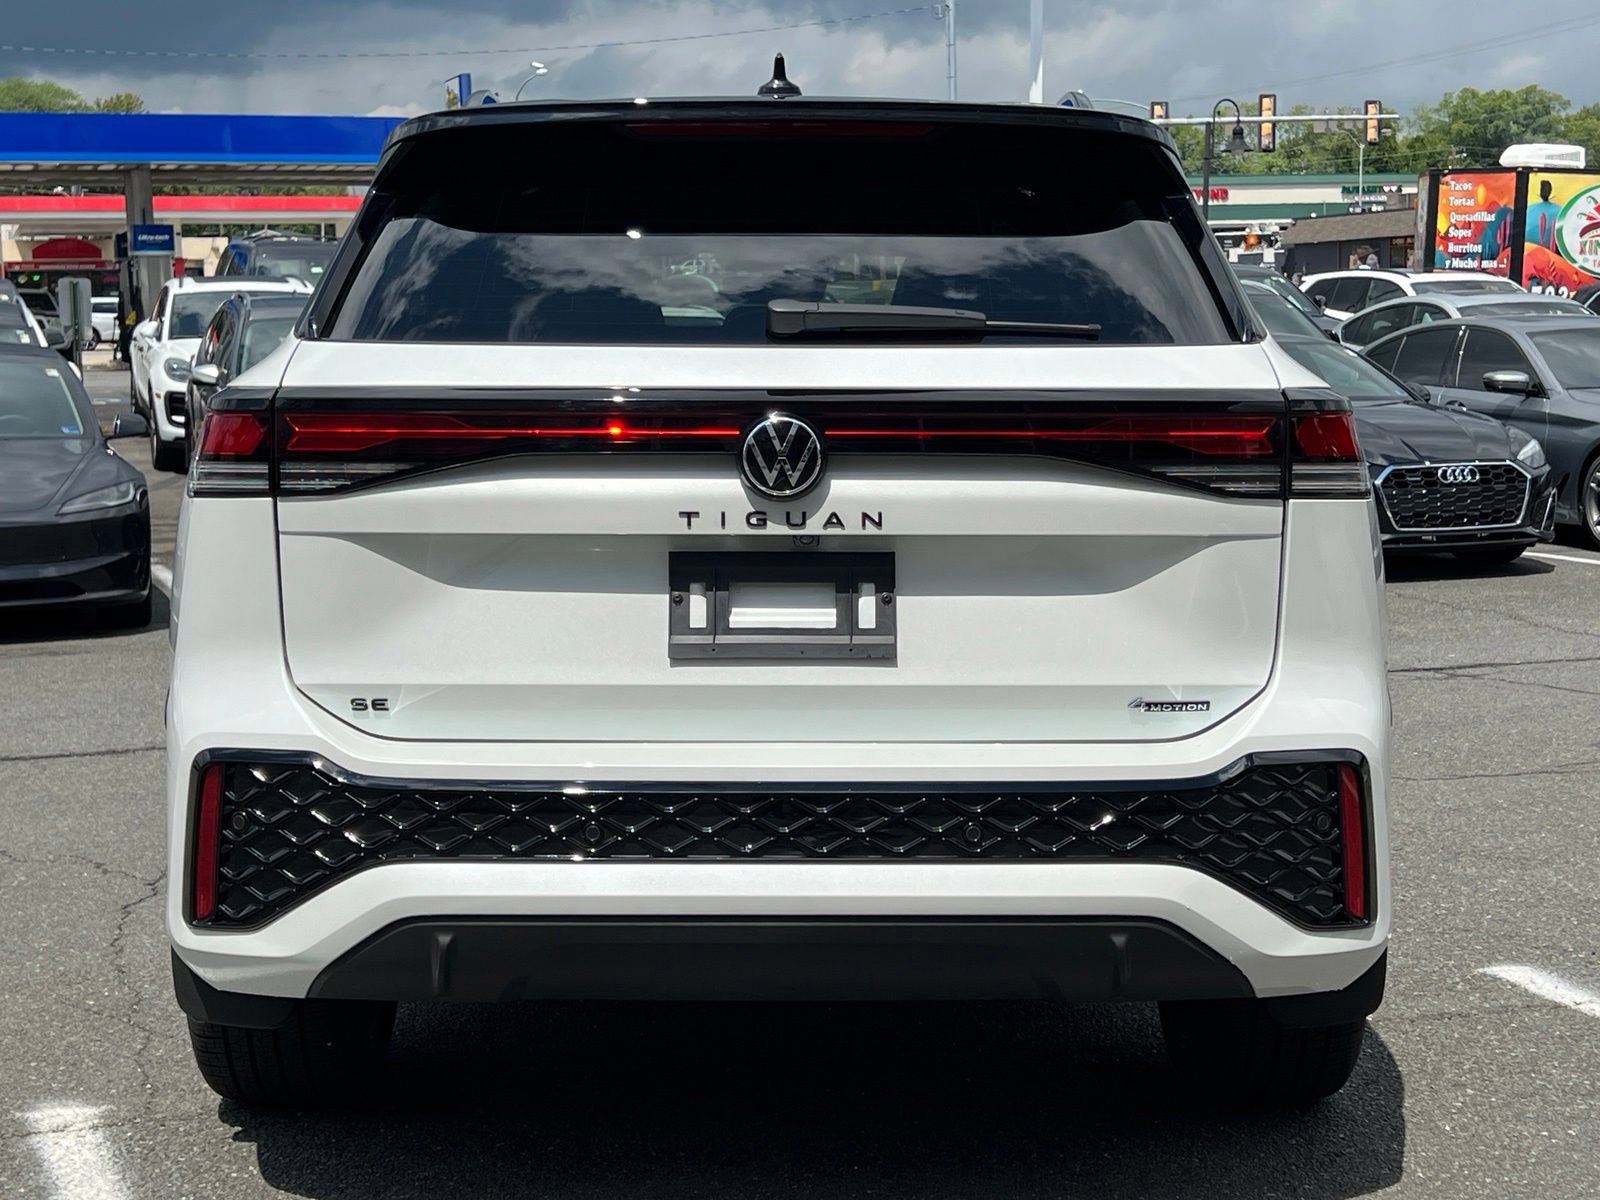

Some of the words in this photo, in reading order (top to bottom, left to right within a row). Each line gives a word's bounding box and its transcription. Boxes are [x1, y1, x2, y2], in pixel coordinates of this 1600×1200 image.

[1450, 181, 1473, 191] Tacos
[1449, 197, 1475, 207] Tortas
[1450, 212, 1496, 223] Quesadillas
[1448, 226, 1472, 238] Sopes
[1448, 242, 1482, 253] Burritos
[1451, 257, 1478, 269] Mucho
[679, 511, 883, 530] TIGUAN
[350, 698, 389, 711] SE
[1128, 697, 1211, 712] 4MOTION
